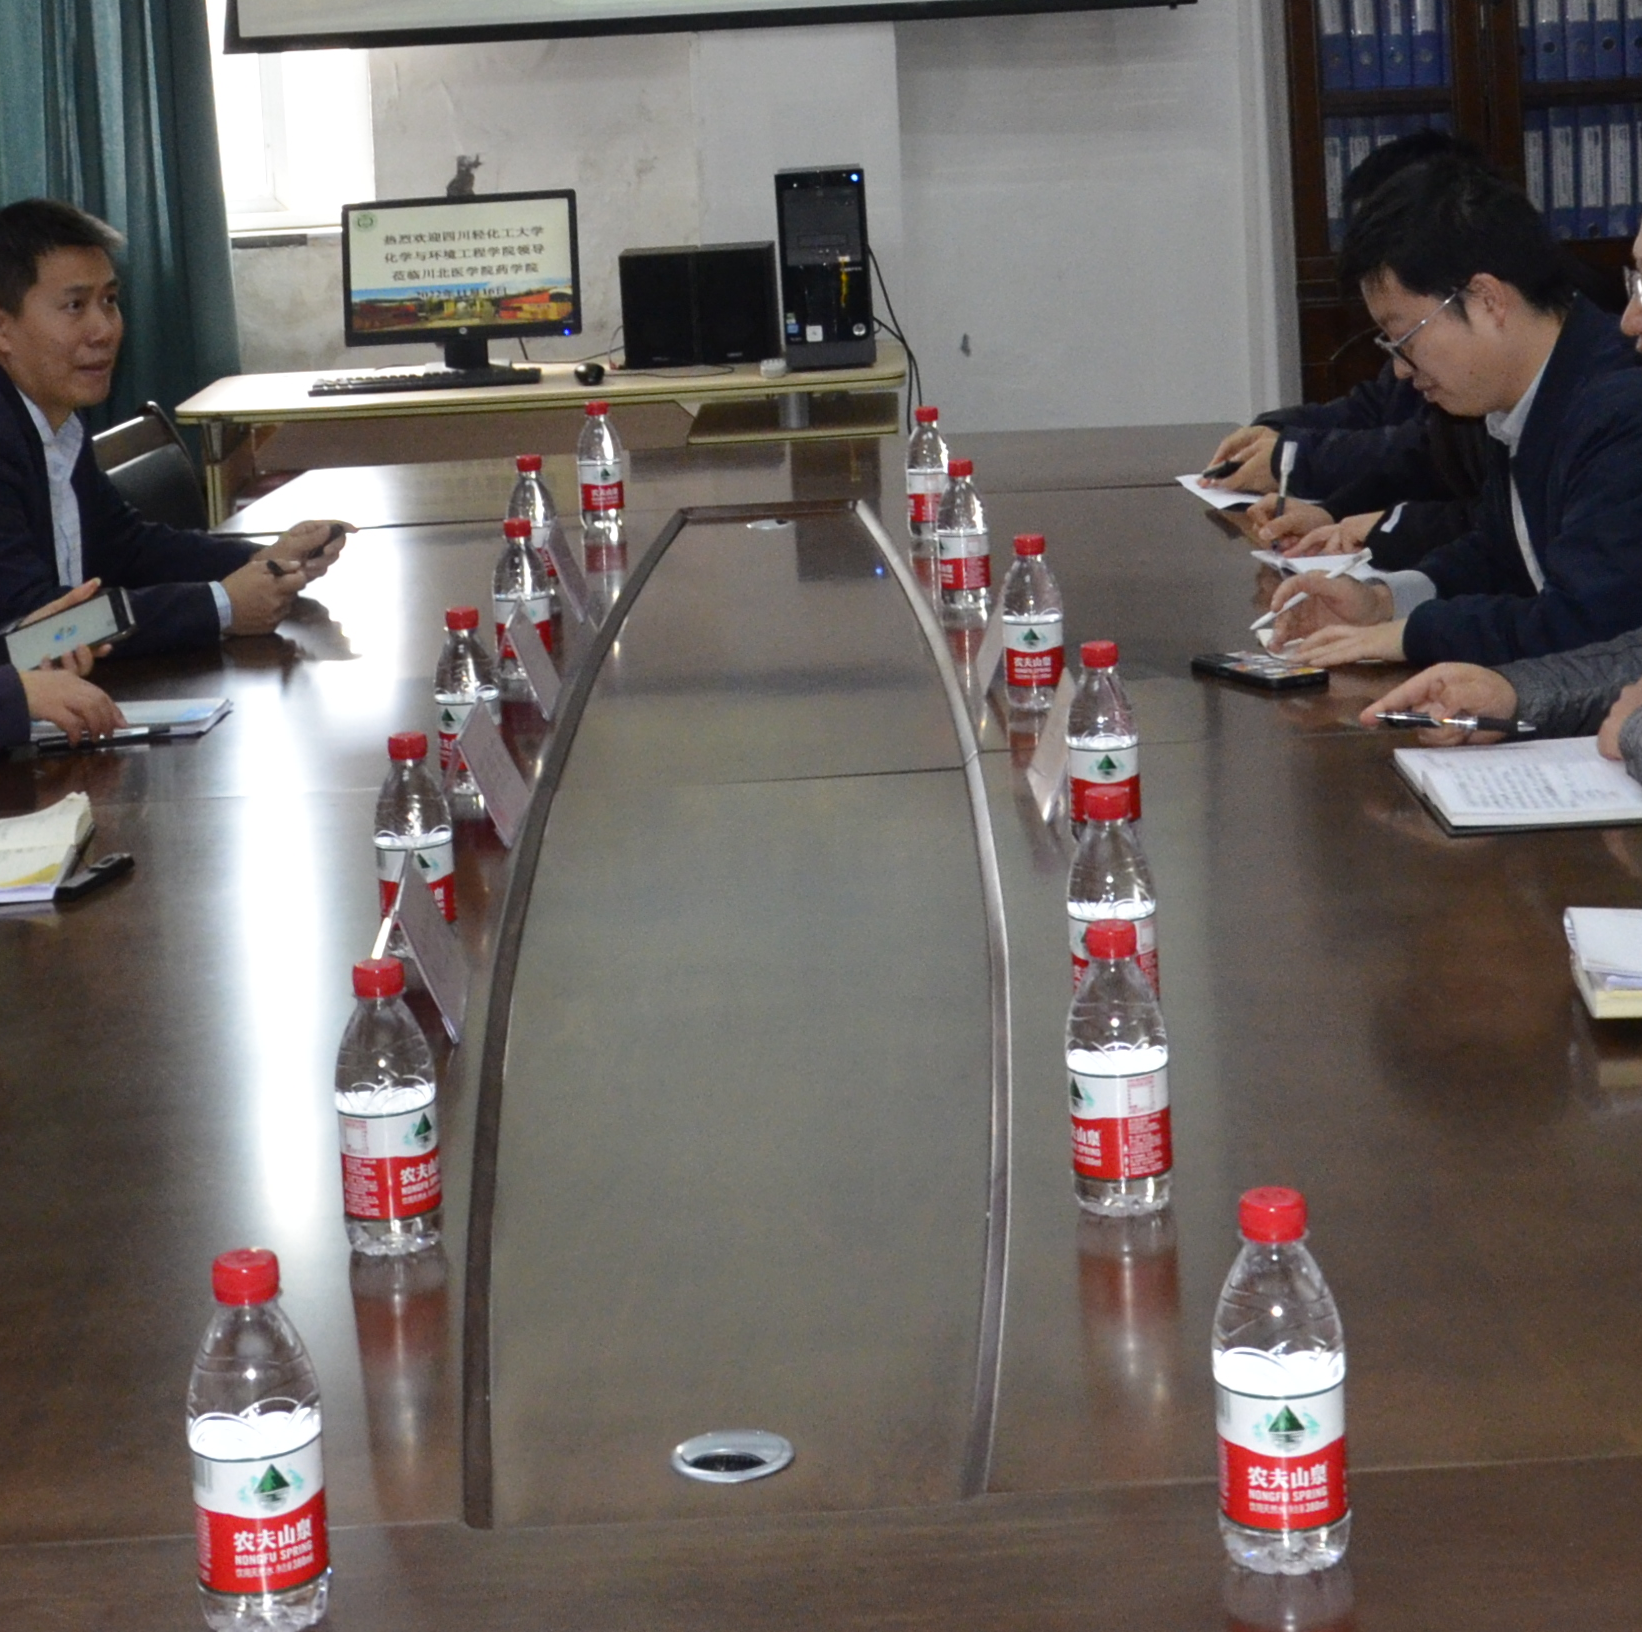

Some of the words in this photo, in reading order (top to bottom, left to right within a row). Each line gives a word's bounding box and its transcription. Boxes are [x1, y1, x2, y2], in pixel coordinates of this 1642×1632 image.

[383, 225, 545, 246] 热烈欢迎四川轻化工大学
[384, 243, 546, 263] 化学与环境工程学院领导
[1247, 1463, 1328, 1489] 农夫山泉
[233, 1518, 313, 1553] 农夫山泉
[234, 1552, 278, 1566] NONGFU
[279, 1539, 313, 1561] SPRING
